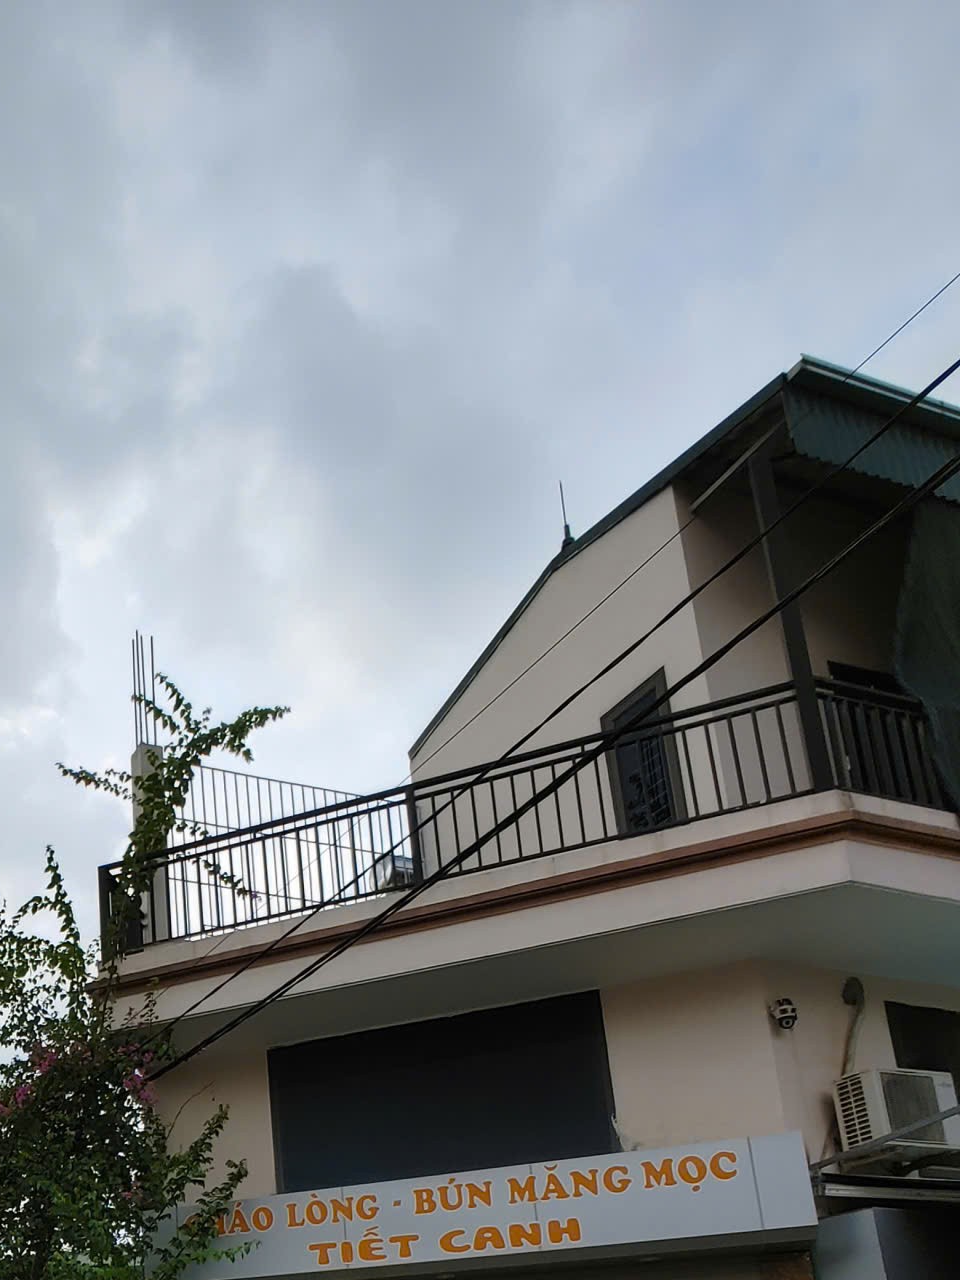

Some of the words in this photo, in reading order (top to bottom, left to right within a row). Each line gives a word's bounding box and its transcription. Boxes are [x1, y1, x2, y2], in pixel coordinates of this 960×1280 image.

[183, 1202, 274, 1238] ÁO
[286, 1193, 380, 1228] LÒNG
[413, 1177, 493, 1215] BÚN
[507, 1164, 632, 1205] MĂNG
[641, 1151, 738, 1192] MỌC
[308, 1225, 420, 1266] TIẾT
[439, 1217, 582, 1254] CANH
